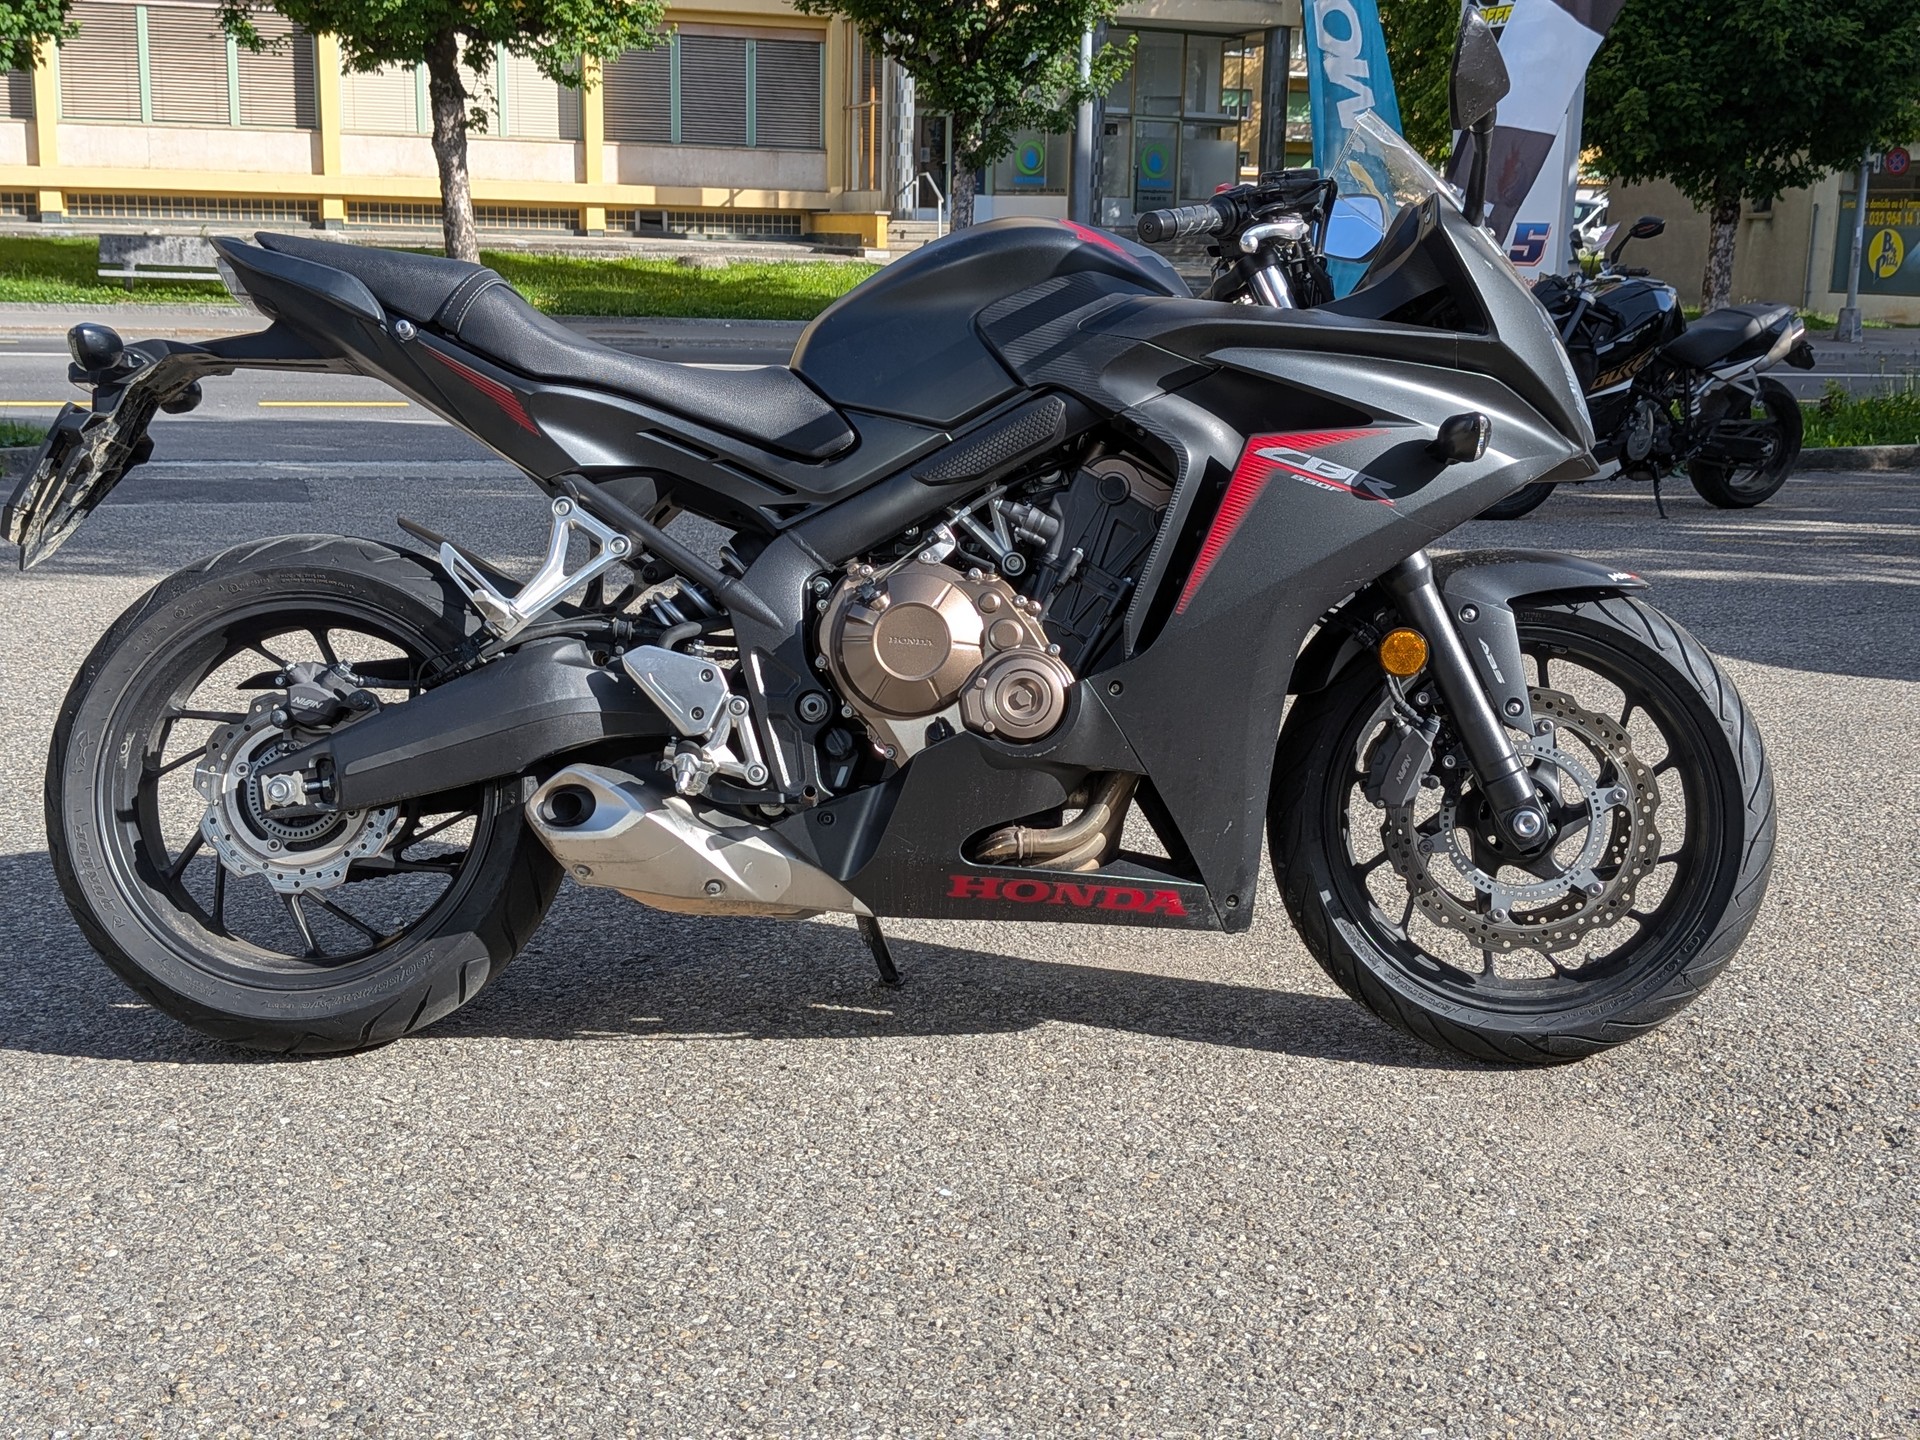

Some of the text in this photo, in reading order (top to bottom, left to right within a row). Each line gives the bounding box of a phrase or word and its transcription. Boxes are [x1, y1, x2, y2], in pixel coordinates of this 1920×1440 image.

[1869, 210, 1885, 226] 032
[1886, 210, 1901, 226] 964
[1253, 446, 1397, 503] CBR
[1290, 474, 1345, 494] 650F
[888, 636, 933, 647] HONDA
[1478, 637, 1506, 684] ABS
[73, 824, 117, 912] DUNLOP
[946, 874, 1189, 917] HONDA
